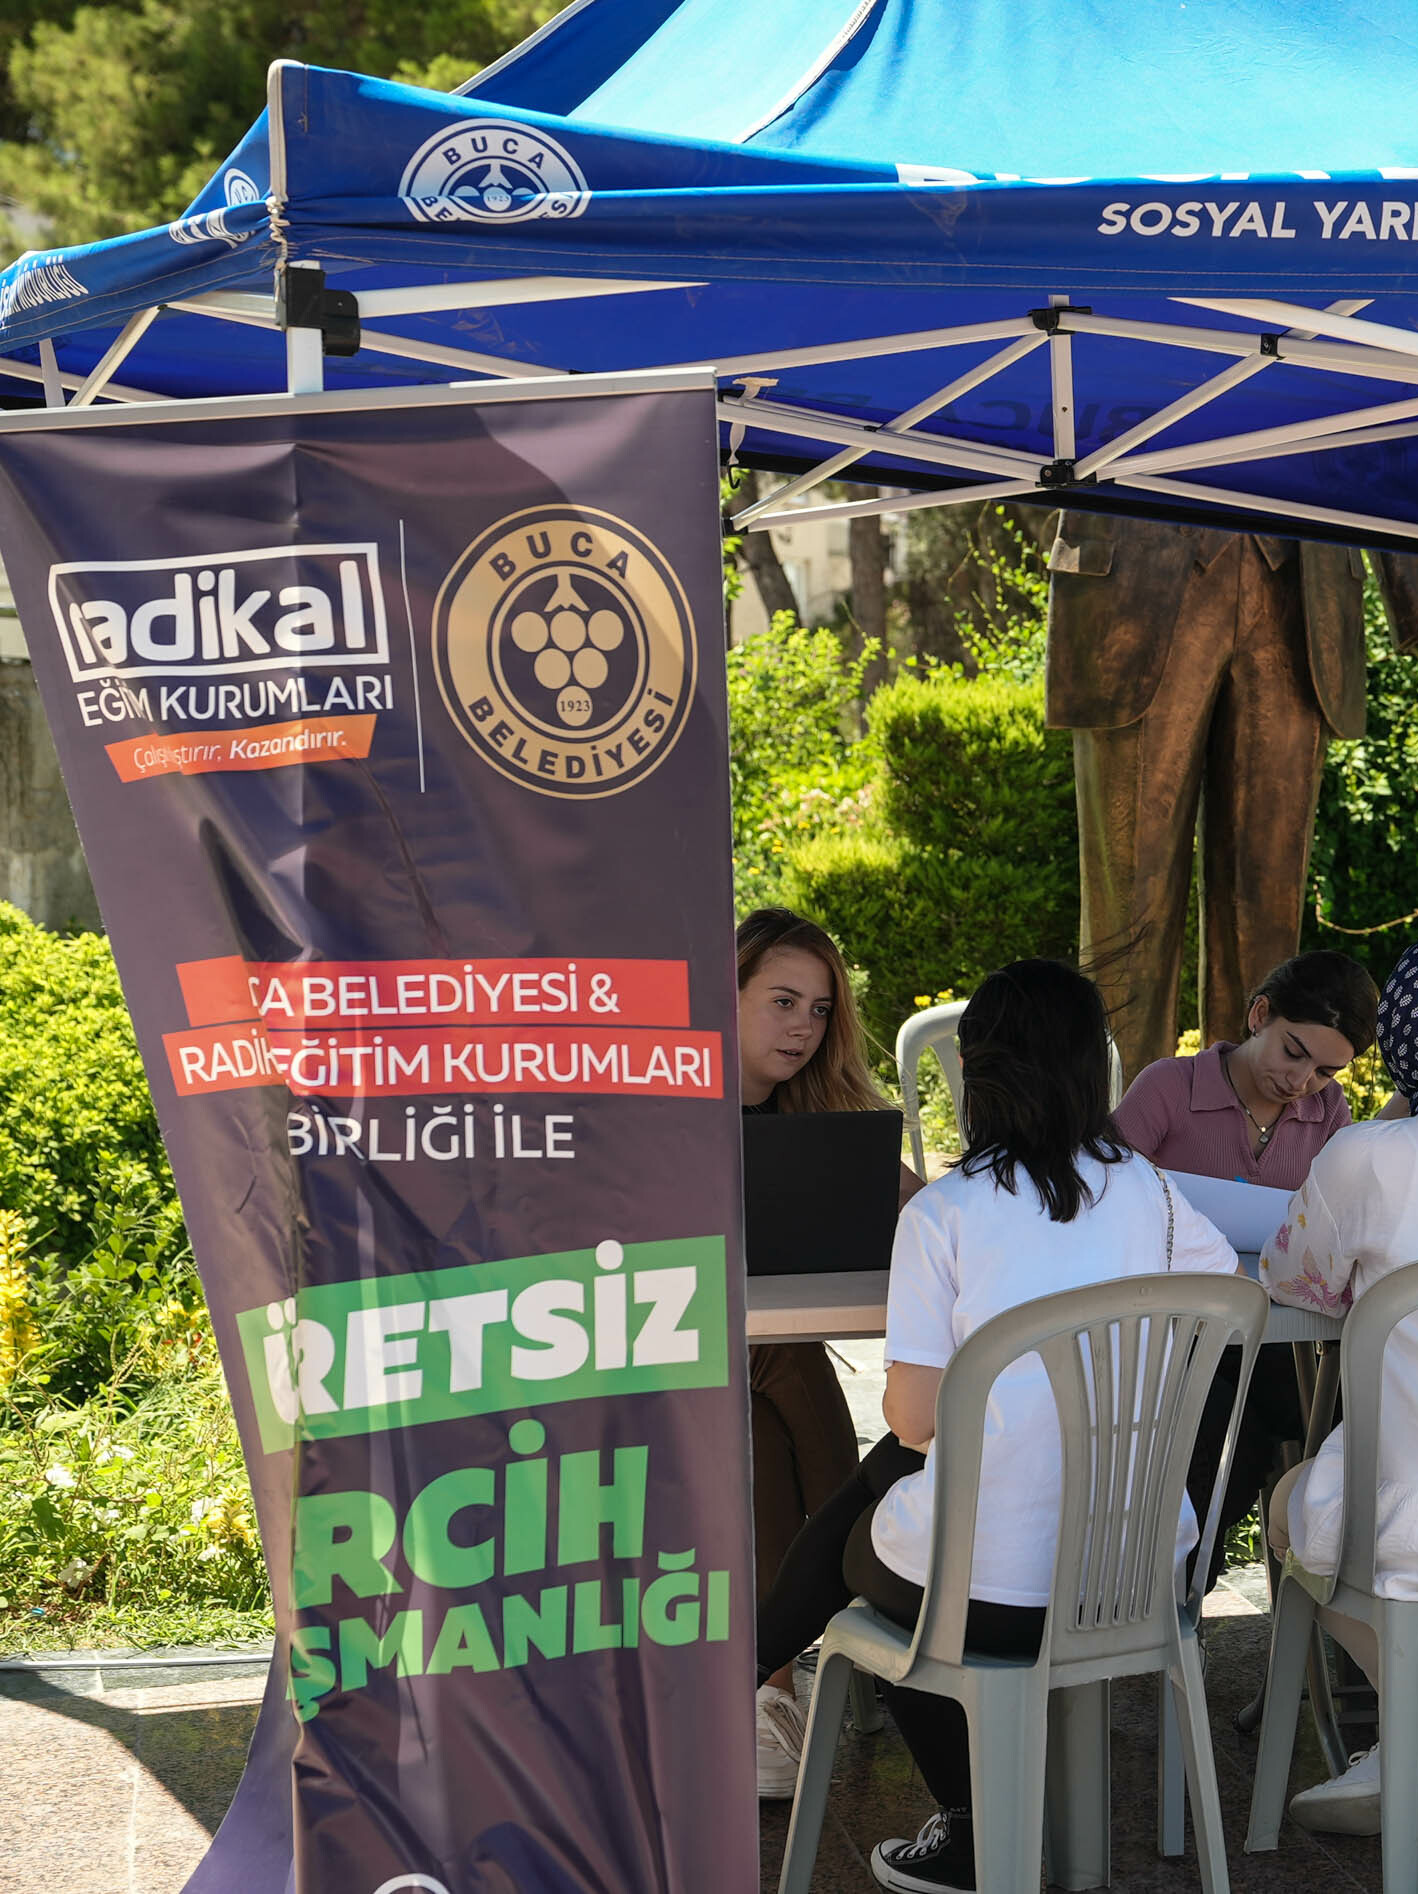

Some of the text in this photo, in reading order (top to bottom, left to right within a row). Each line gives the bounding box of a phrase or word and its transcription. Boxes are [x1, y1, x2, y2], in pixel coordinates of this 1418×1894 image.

[442, 136, 545, 169] BUCA
[1097, 201, 1297, 239] SOSYAL
[488, 531, 630, 581] BUCA
[160, 675, 394, 721] KURUMLARI
[559, 700, 591, 713] 1923
[229, 729, 347, 760] Kazandırır.
[468, 688, 674, 780] BELEDİYESİ
[302, 963, 578, 1017] BELEDİYESİ
[588, 972, 620, 1014] &
[444, 1043, 711, 1088] KURUMLARI
[494, 1104, 576, 1160] İLE
